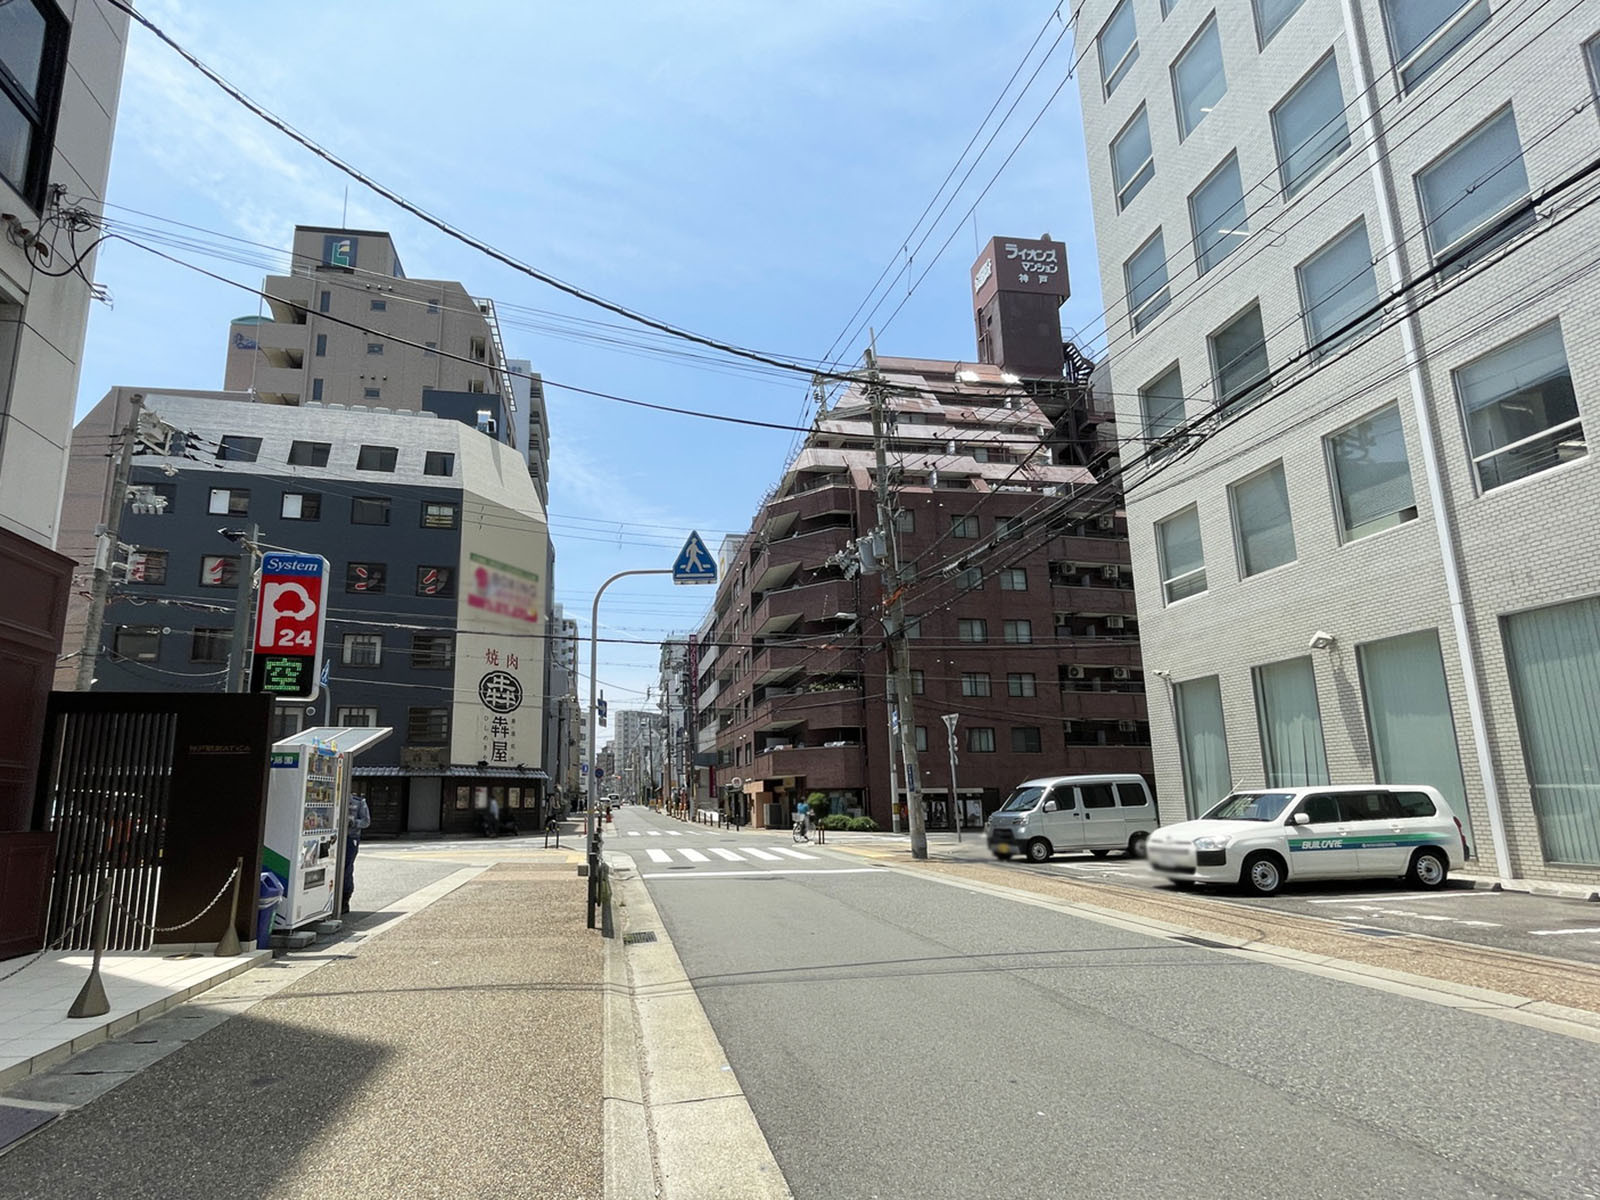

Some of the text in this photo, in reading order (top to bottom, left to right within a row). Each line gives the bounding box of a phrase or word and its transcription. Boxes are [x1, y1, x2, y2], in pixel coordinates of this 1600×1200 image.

[1005, 244, 1058, 263] ライオンズ
[1022, 262, 1059, 274] マンション
[1018, 273, 1049, 284] 神戸
[266, 557, 319, 573] System
[277, 628, 313, 648] 24
[484, 647, 520, 671] 焼肉
[490, 715, 510, 763] 犇屋
